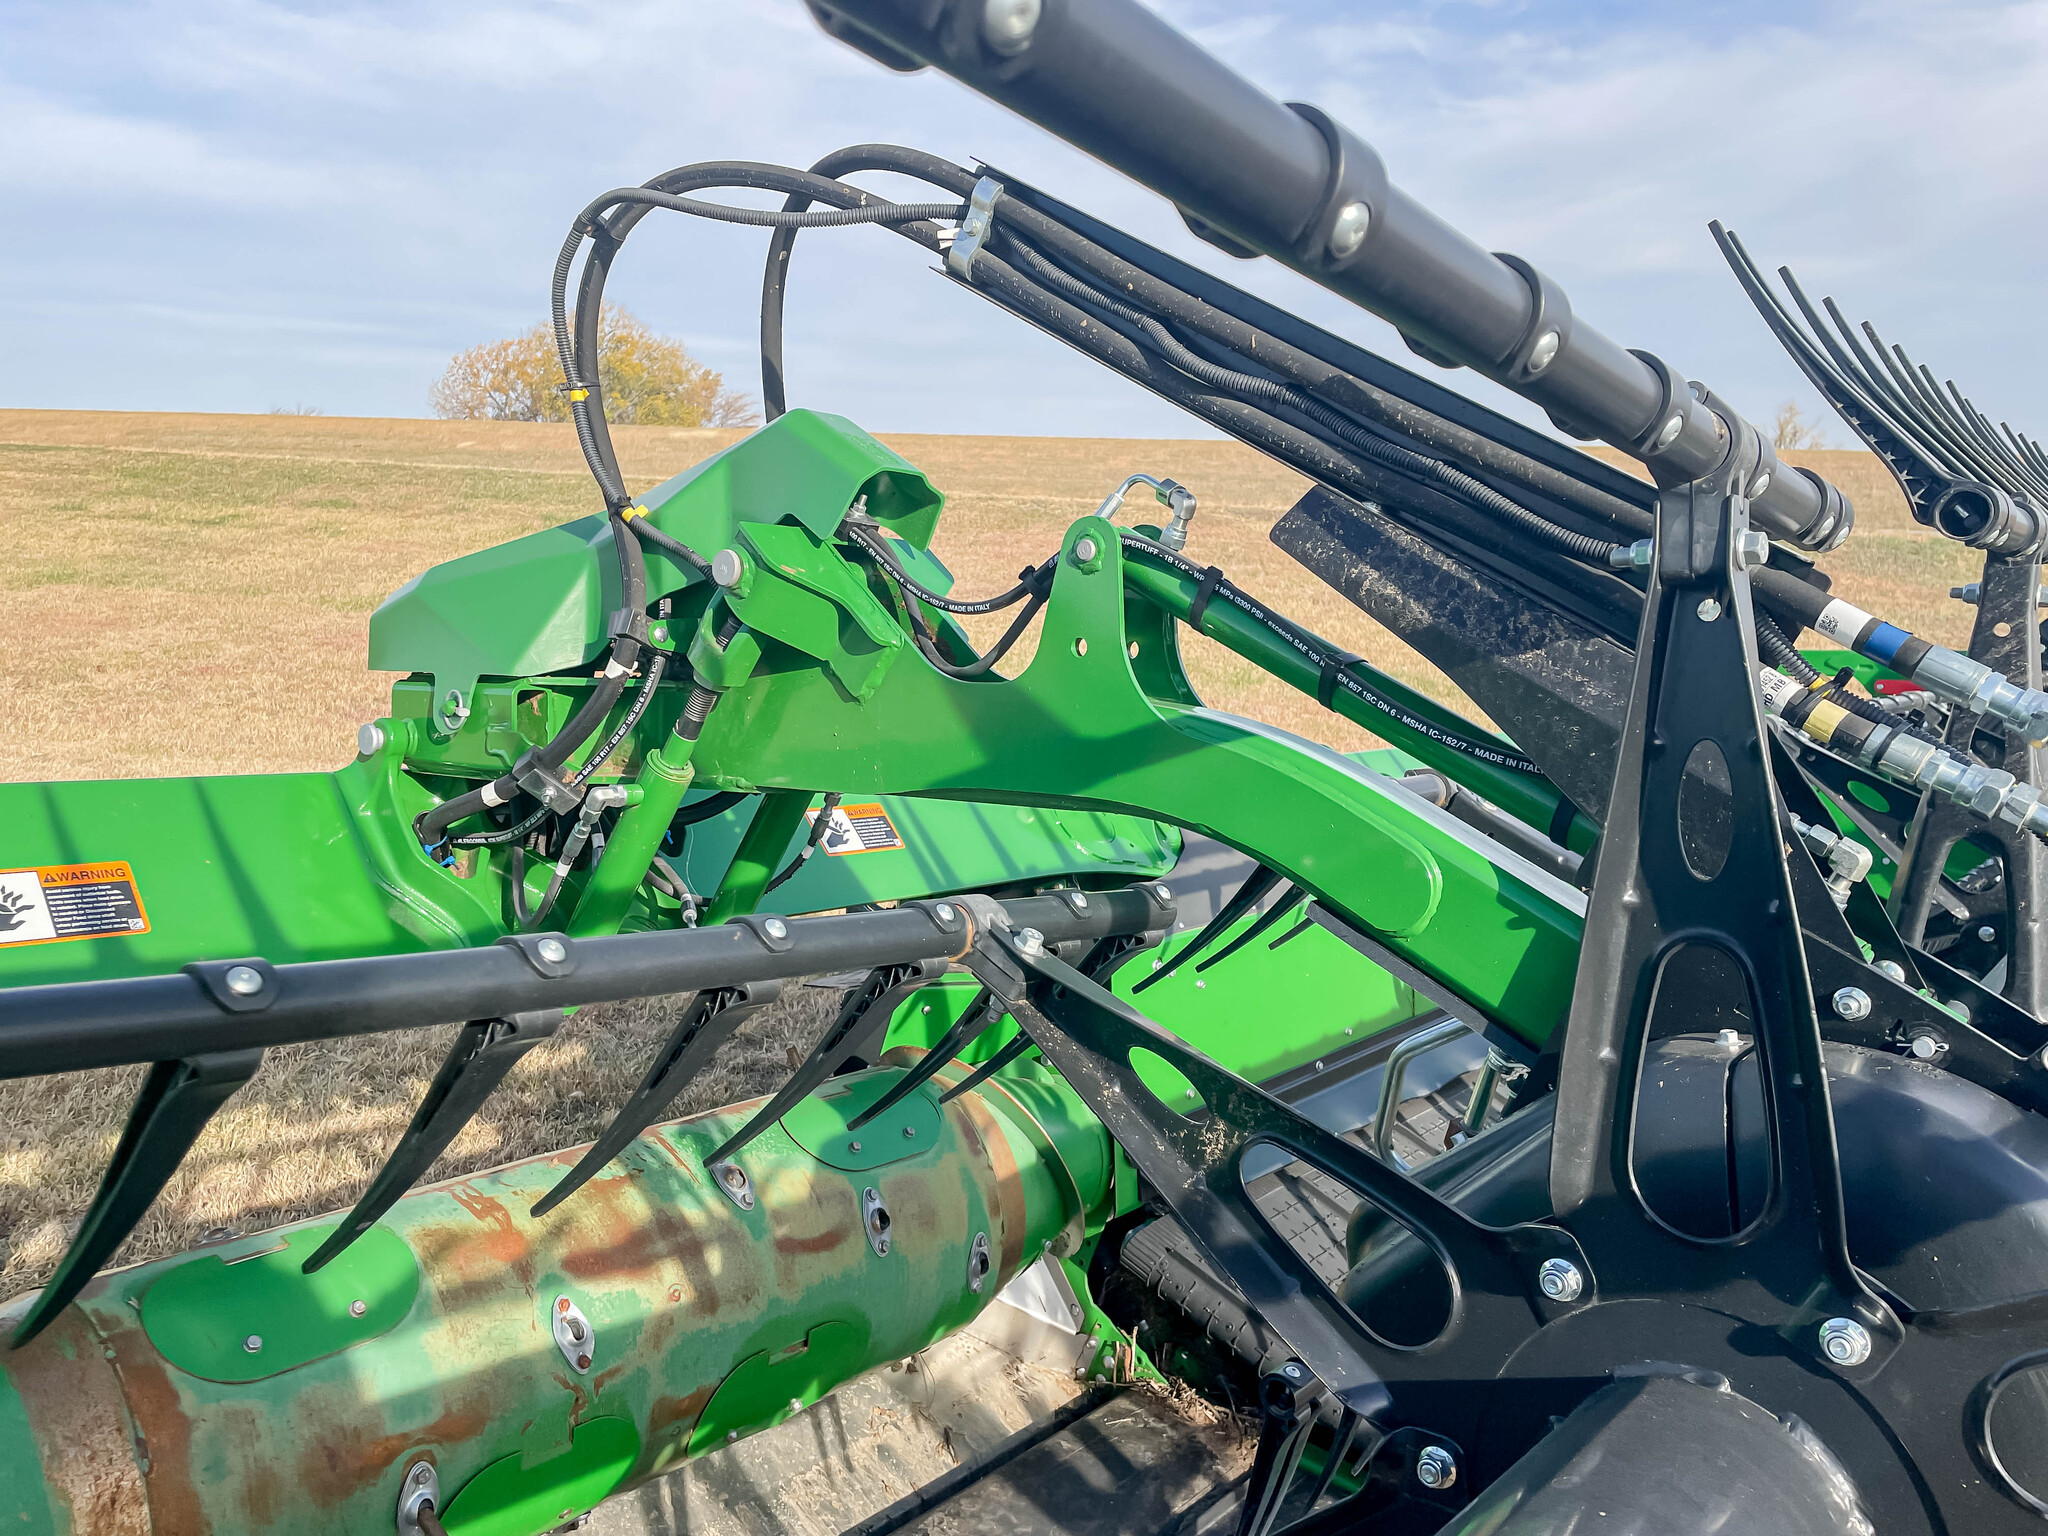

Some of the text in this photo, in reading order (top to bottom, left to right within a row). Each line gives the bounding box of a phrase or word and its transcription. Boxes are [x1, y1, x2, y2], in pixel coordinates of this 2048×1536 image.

[857, 537, 867, 548] R17
[868, 548, 877, 557] EN
[892, 571, 901, 581] DN
[906, 582, 922, 597] MSHA
[921, 594, 945, 608] IC-152/7
[948, 603, 967, 612] MADE
[974, 602, 991, 612] ITALY
[1121, 537, 1159, 555] UPERTUFF
[1164, 554, 1174, 564] 1B
[1193, 570, 1206, 582] WP
[1219, 586, 1234, 600] MPa
[1267, 620, 1294, 643] exceeds
[1293, 639, 1309, 654] SAE
[1308, 650, 1320, 663] 100
[1337, 673, 1349, 685] EN
[1348, 681, 1363, 694] 857
[1362, 690, 1378, 705] 1SC
[1377, 700, 1391, 713] DN
[1390, 708, 1397, 717] 6
[1401, 714, 1427, 734] MSHA
[1428, 728, 1468, 751] IC-152/7
[1474, 747, 1505, 764] MADE
[1505, 757, 1518, 768] IN
[1770, 678, 1787, 693] MB
[581, 764, 594, 775] SAE
[591, 755, 602, 766] 100
[599, 745, 610, 758] R17
[611, 734, 621, 745] EN
[617, 723, 628, 736] 857
[625, 711, 636, 726] 1SC
[633, 703, 643, 713] DN
[643, 673, 656, 693] MSHA
[853, 807, 883, 816] WARNING
[56, 868, 126, 882] WARNING
